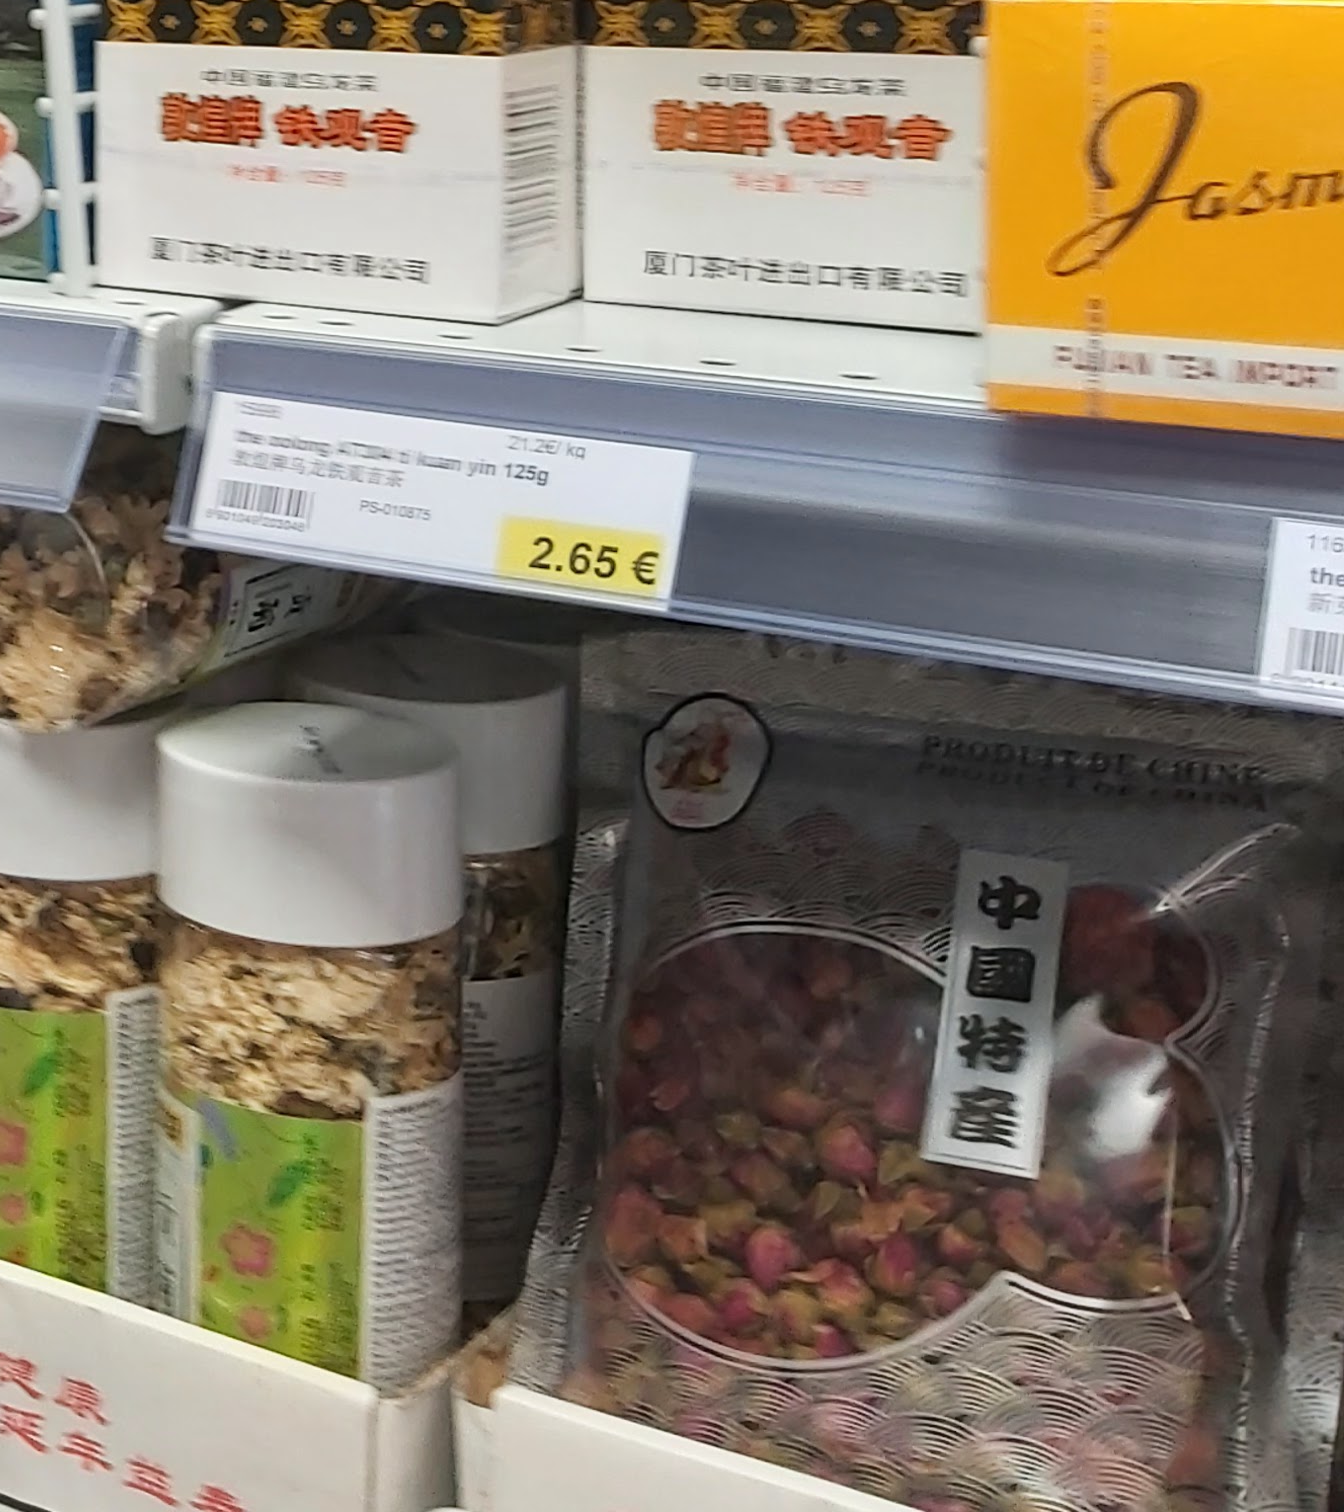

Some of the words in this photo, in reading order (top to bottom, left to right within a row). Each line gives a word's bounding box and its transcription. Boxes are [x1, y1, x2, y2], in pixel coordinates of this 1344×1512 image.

[1164, 353, 1220, 381] TEA
[1235, 359, 1340, 390] IMPORT
[466, 458, 497, 480] yin
[503, 462, 550, 487] 125g
[528, 535, 619, 579] 2.65
[630, 550, 661, 586] €
